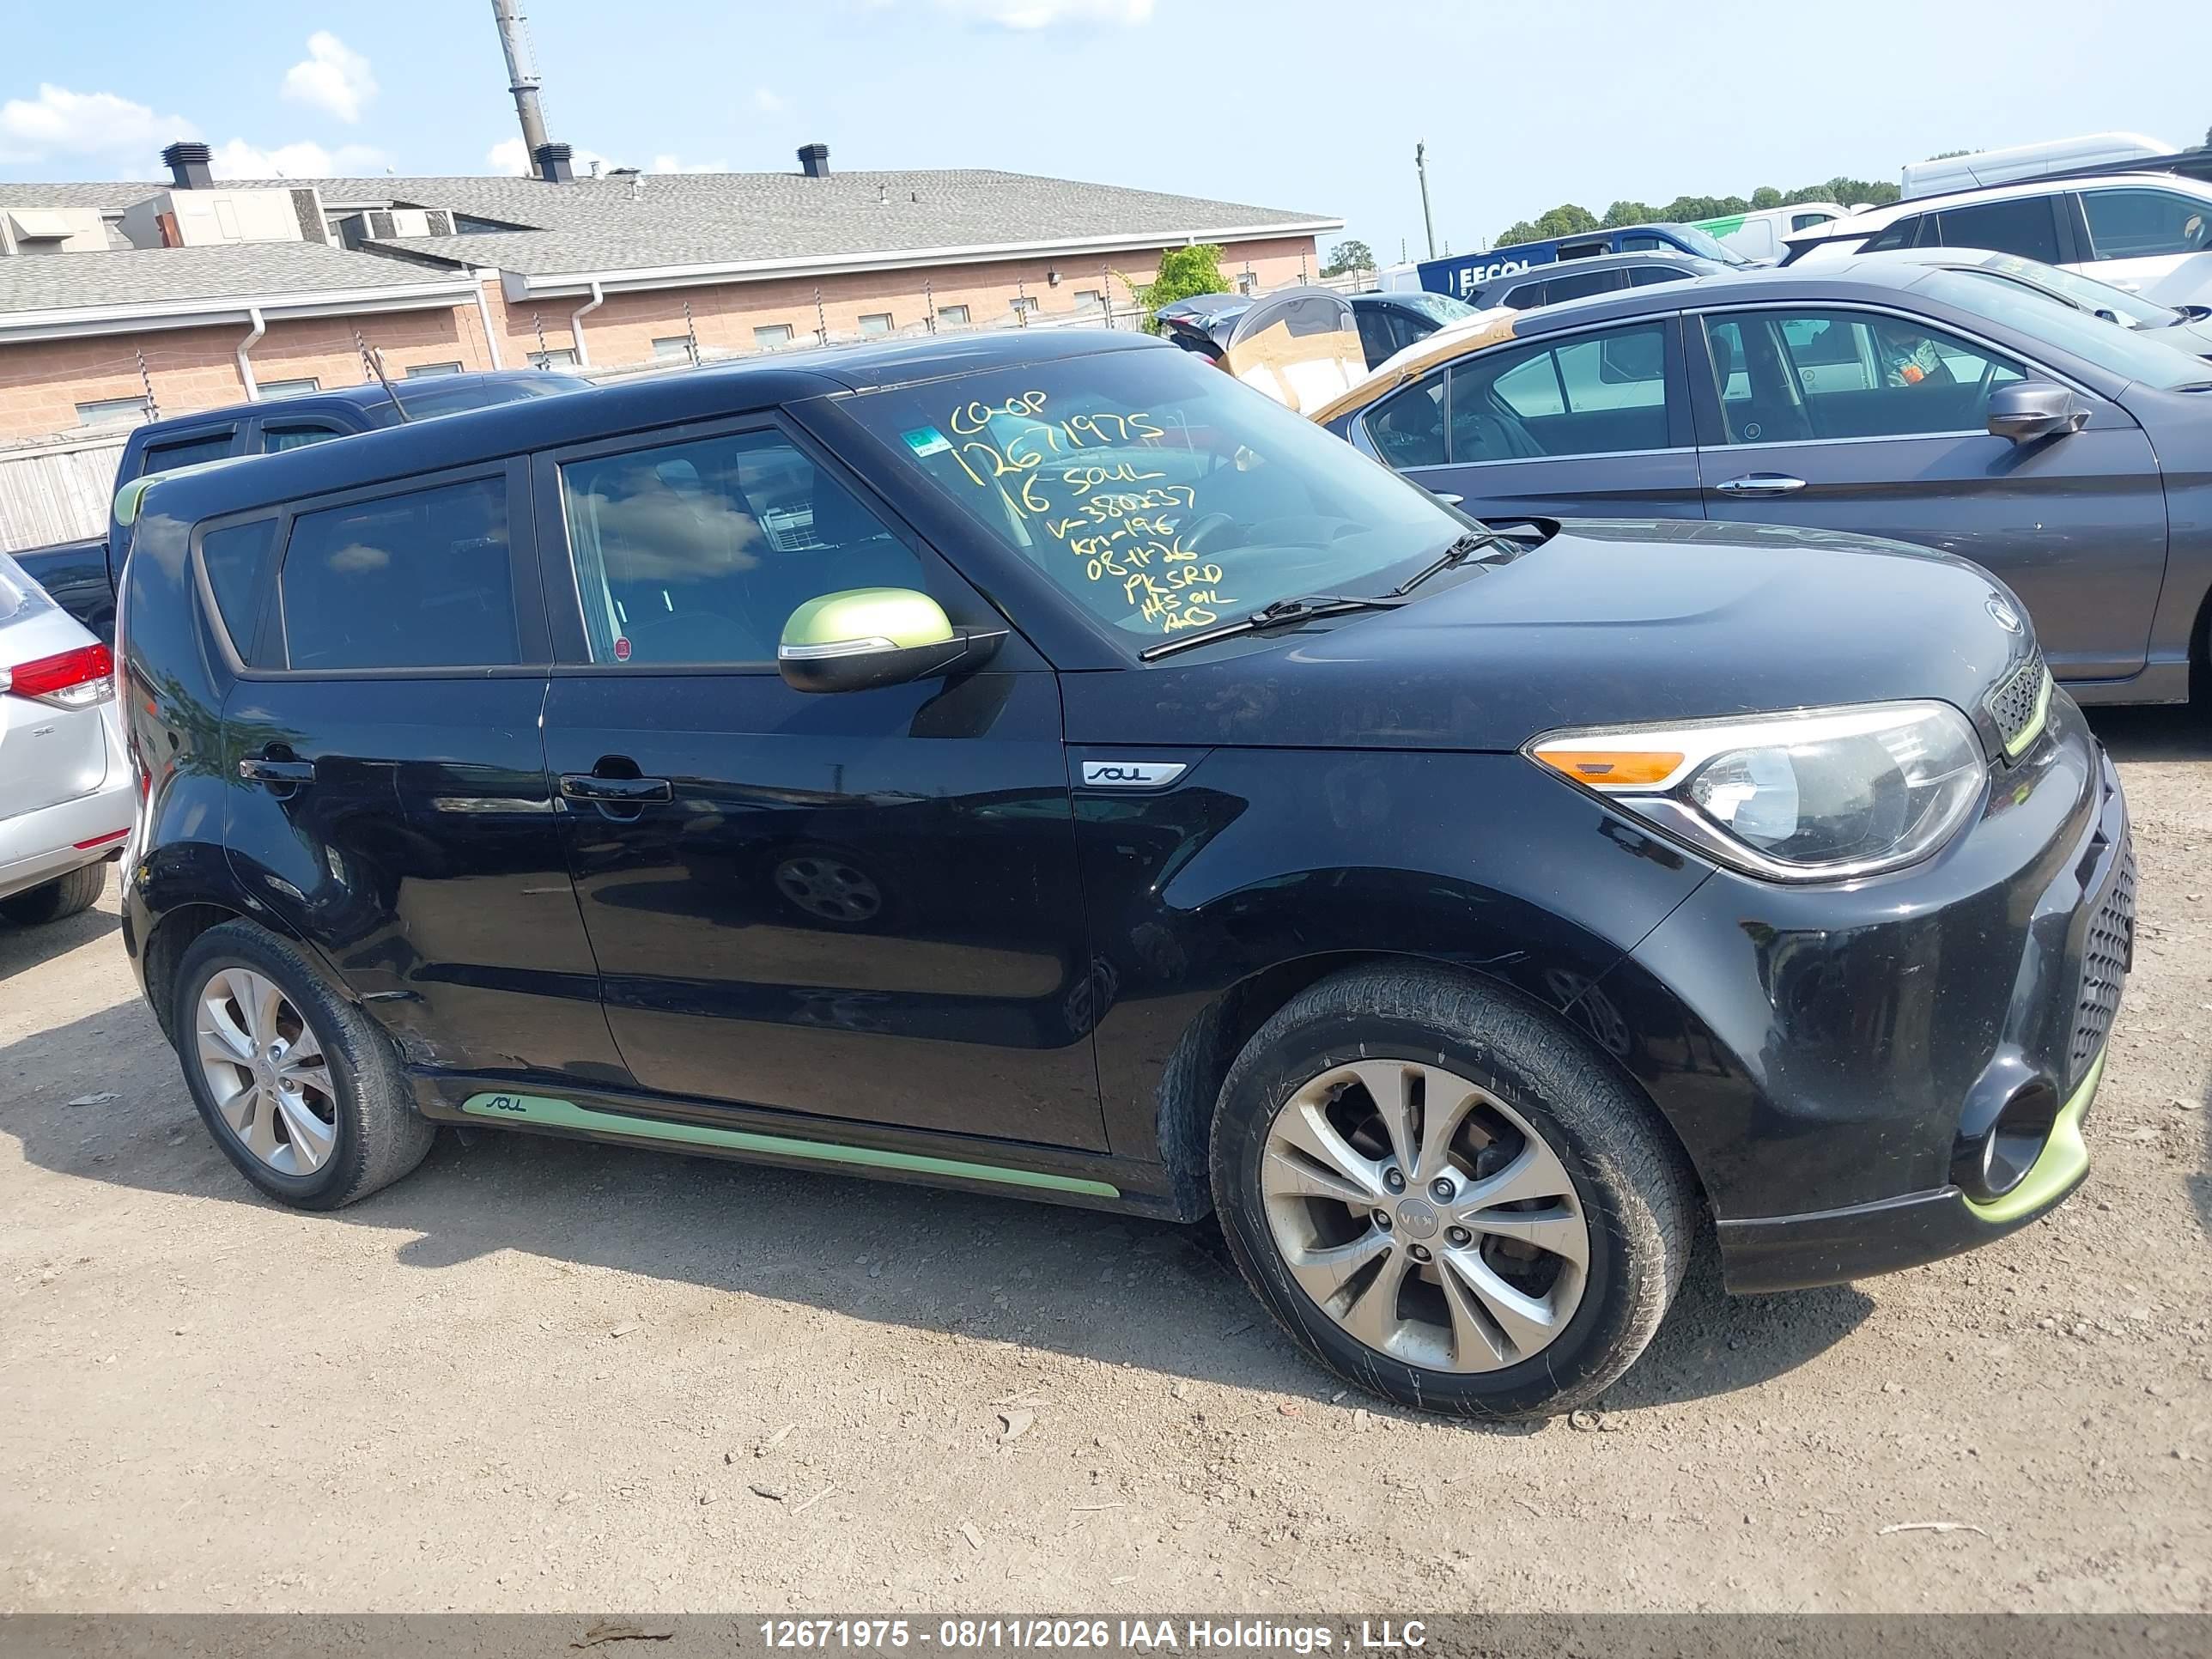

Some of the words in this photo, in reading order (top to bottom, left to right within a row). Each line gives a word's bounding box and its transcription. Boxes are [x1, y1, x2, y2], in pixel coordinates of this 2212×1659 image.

[951, 391, 1048, 434] CO-OP
[951, 413, 1165, 486] 12671975
[1001, 473, 1051, 519] 16
[1063, 463, 1167, 496] SOUL
[1087, 768, 1152, 781] SOUL
[485, 1097, 527, 1113] SOUL
